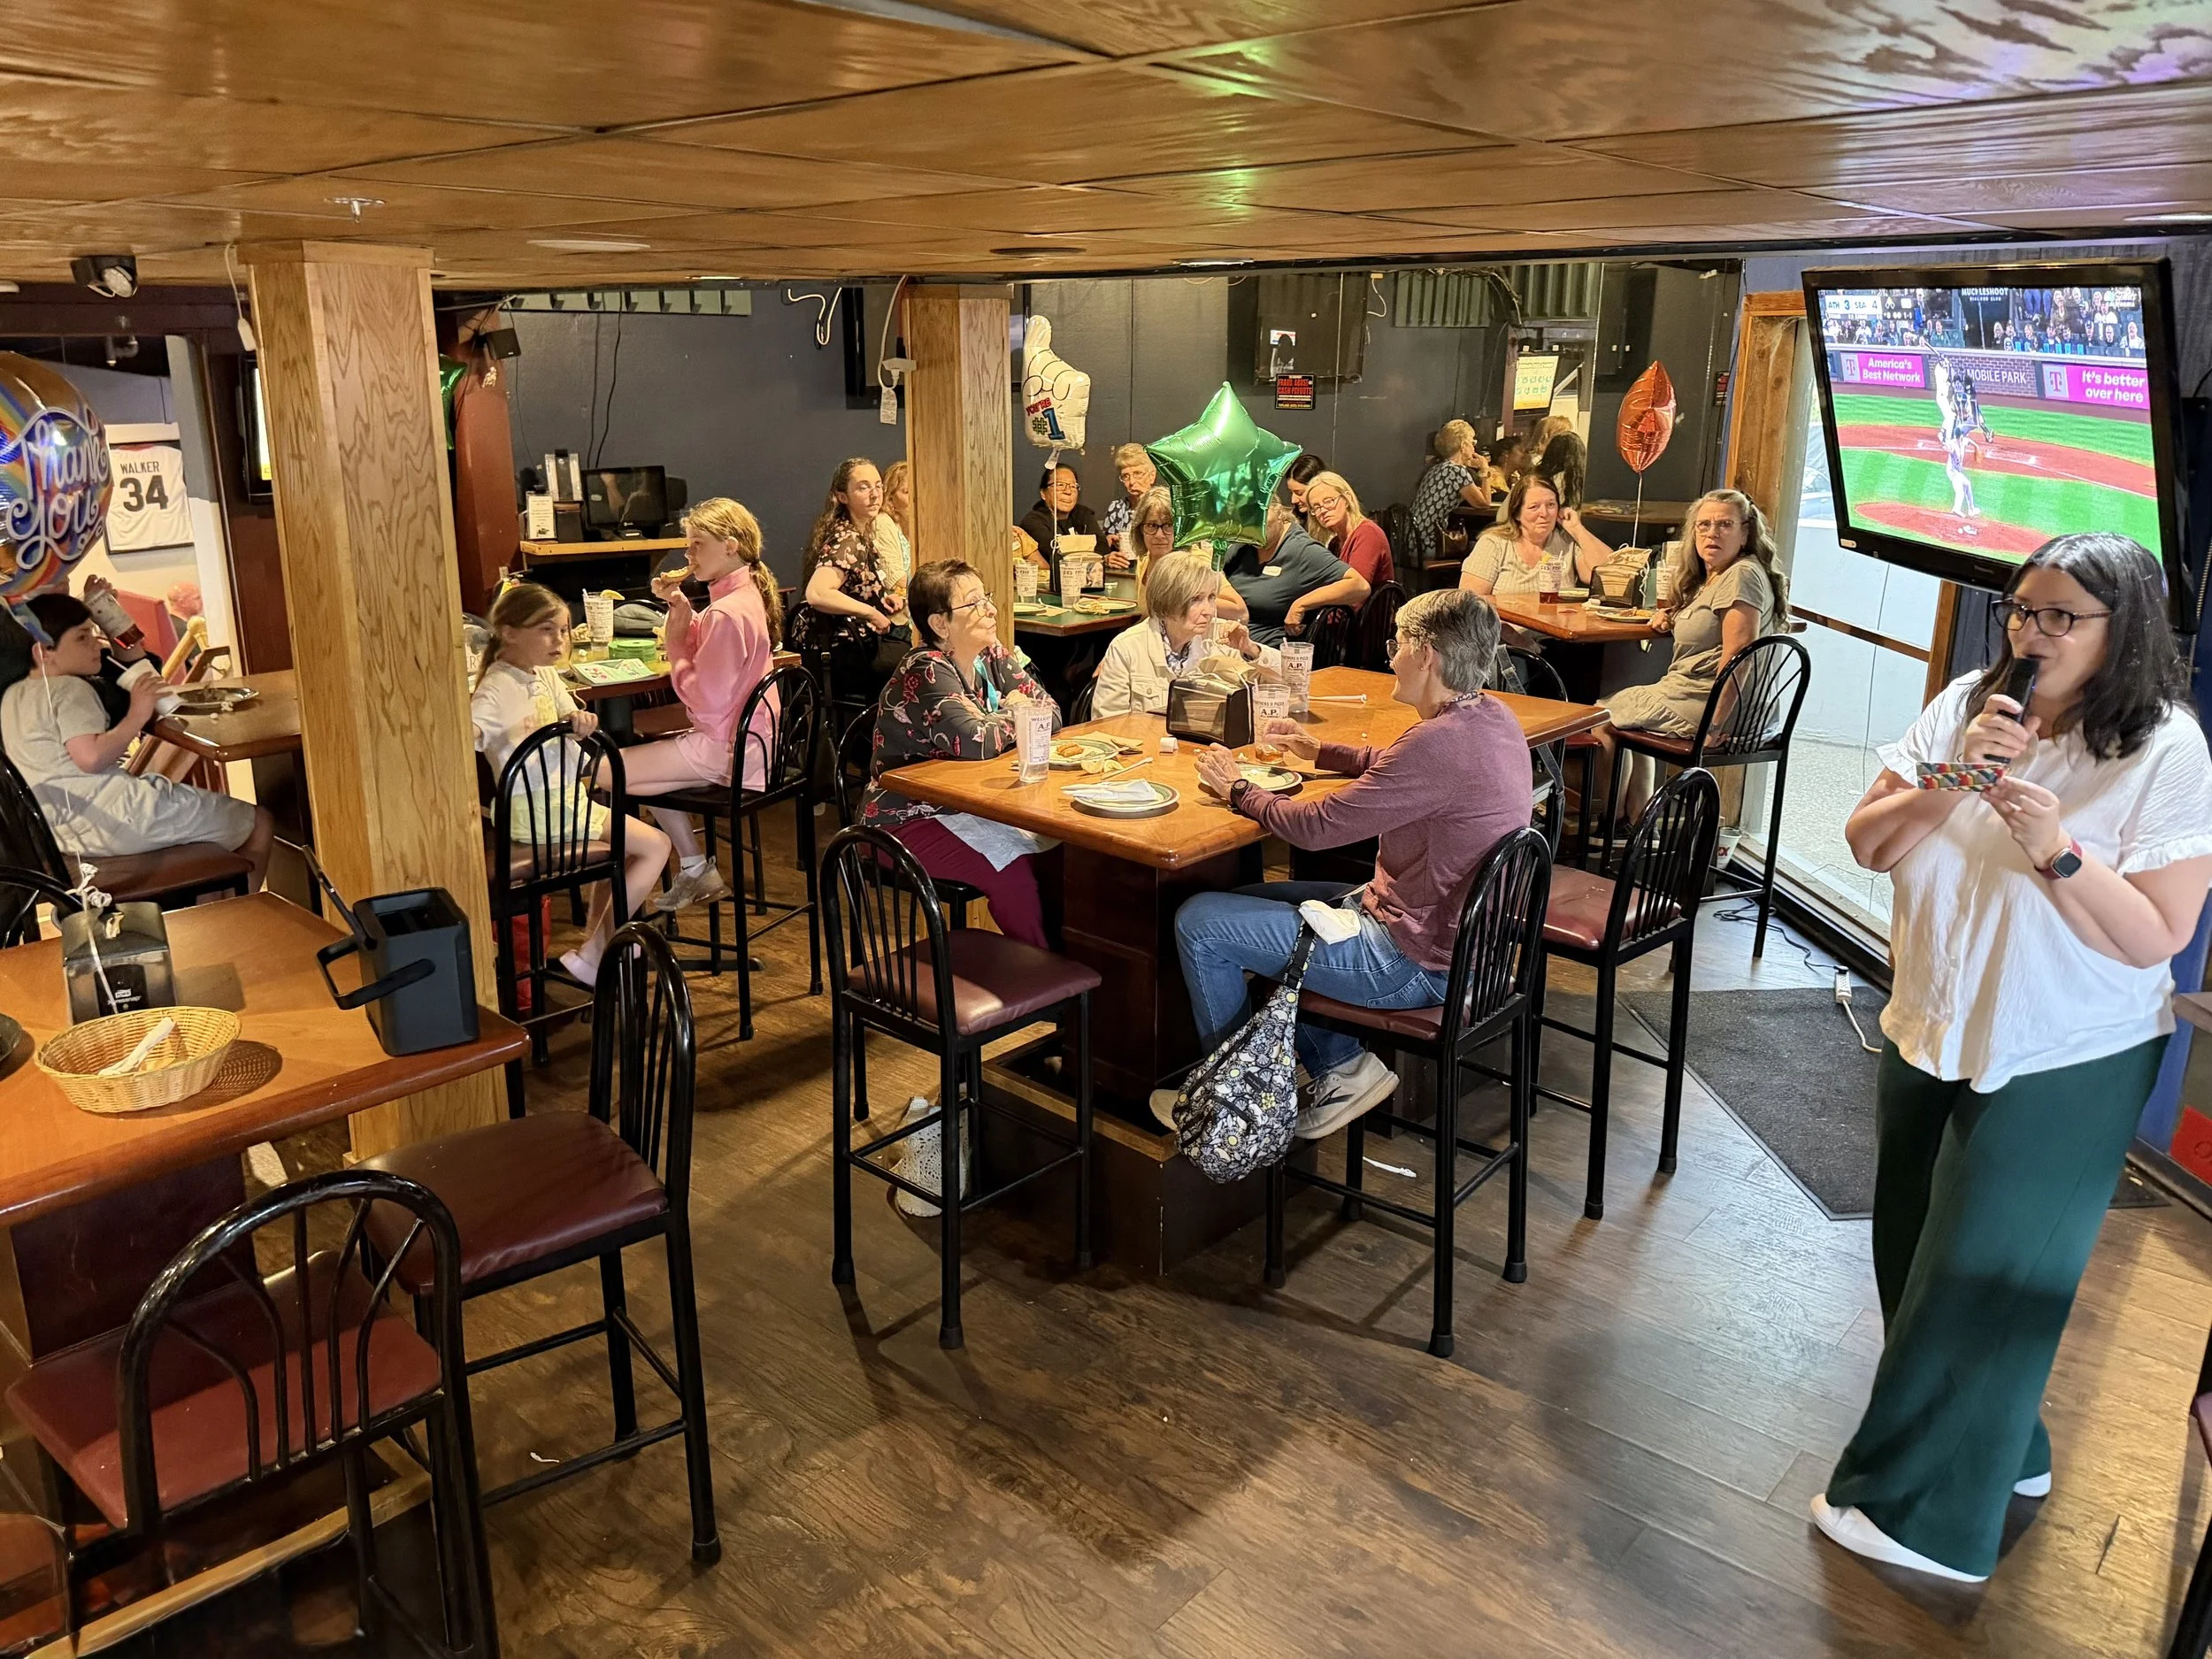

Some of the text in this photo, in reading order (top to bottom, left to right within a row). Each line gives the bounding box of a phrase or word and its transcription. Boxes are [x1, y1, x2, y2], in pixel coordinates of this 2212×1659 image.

[1844, 300, 1850, 310] 3
[1868, 357, 1913, 370] America's
[1862, 369, 1921, 383] Best Network
[2001, 371, 2027, 384] PARK
[2082, 370, 2146, 388] It's better
[2085, 388, 2144, 403] over here
[1032, 408, 1066, 441] #1
[120, 461, 160, 474] WALKER
[119, 474, 169, 512] 34
